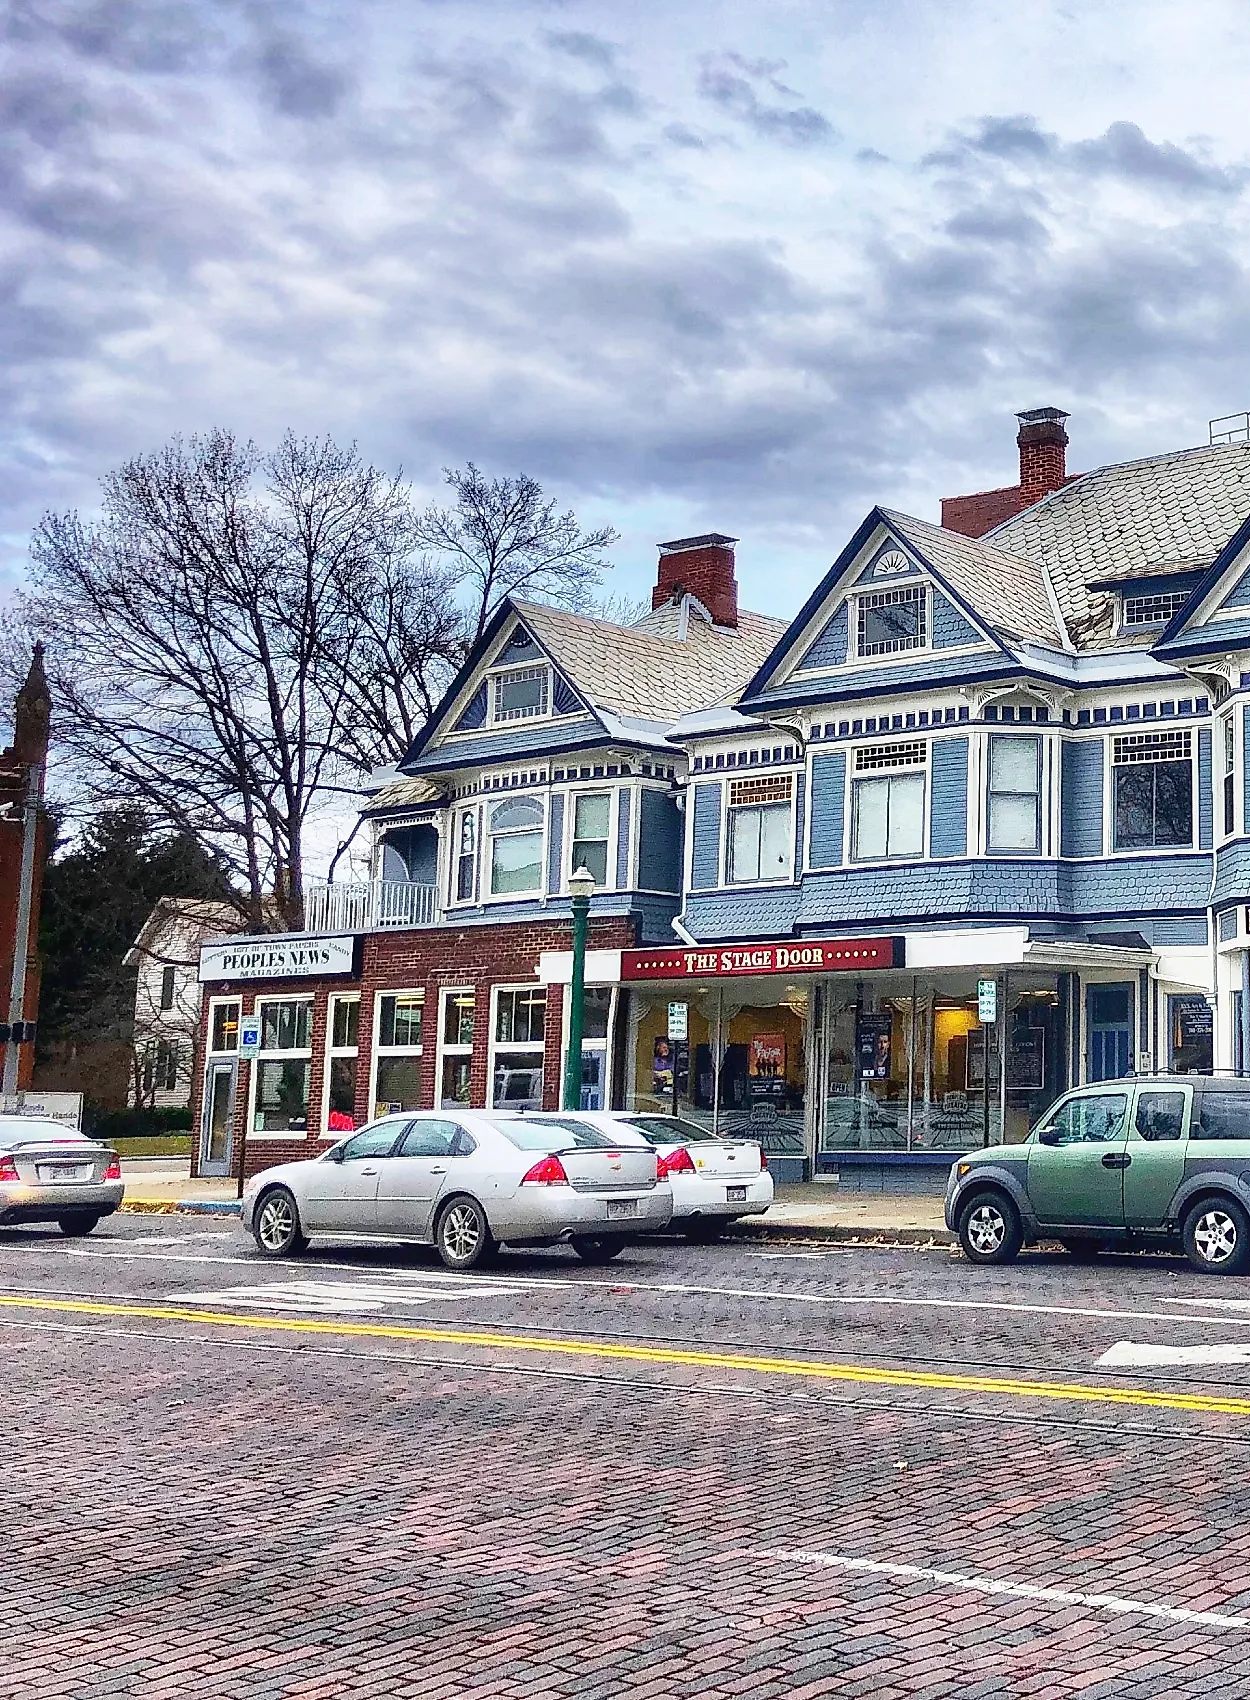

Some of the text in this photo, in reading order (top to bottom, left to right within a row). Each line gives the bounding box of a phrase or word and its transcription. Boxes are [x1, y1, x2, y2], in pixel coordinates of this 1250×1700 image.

[222, 948, 330, 970] PEOPLES NEWS
[683, 948, 824, 973] THE STAGE DOOR
[239, 966, 310, 978] MAGAZINES
